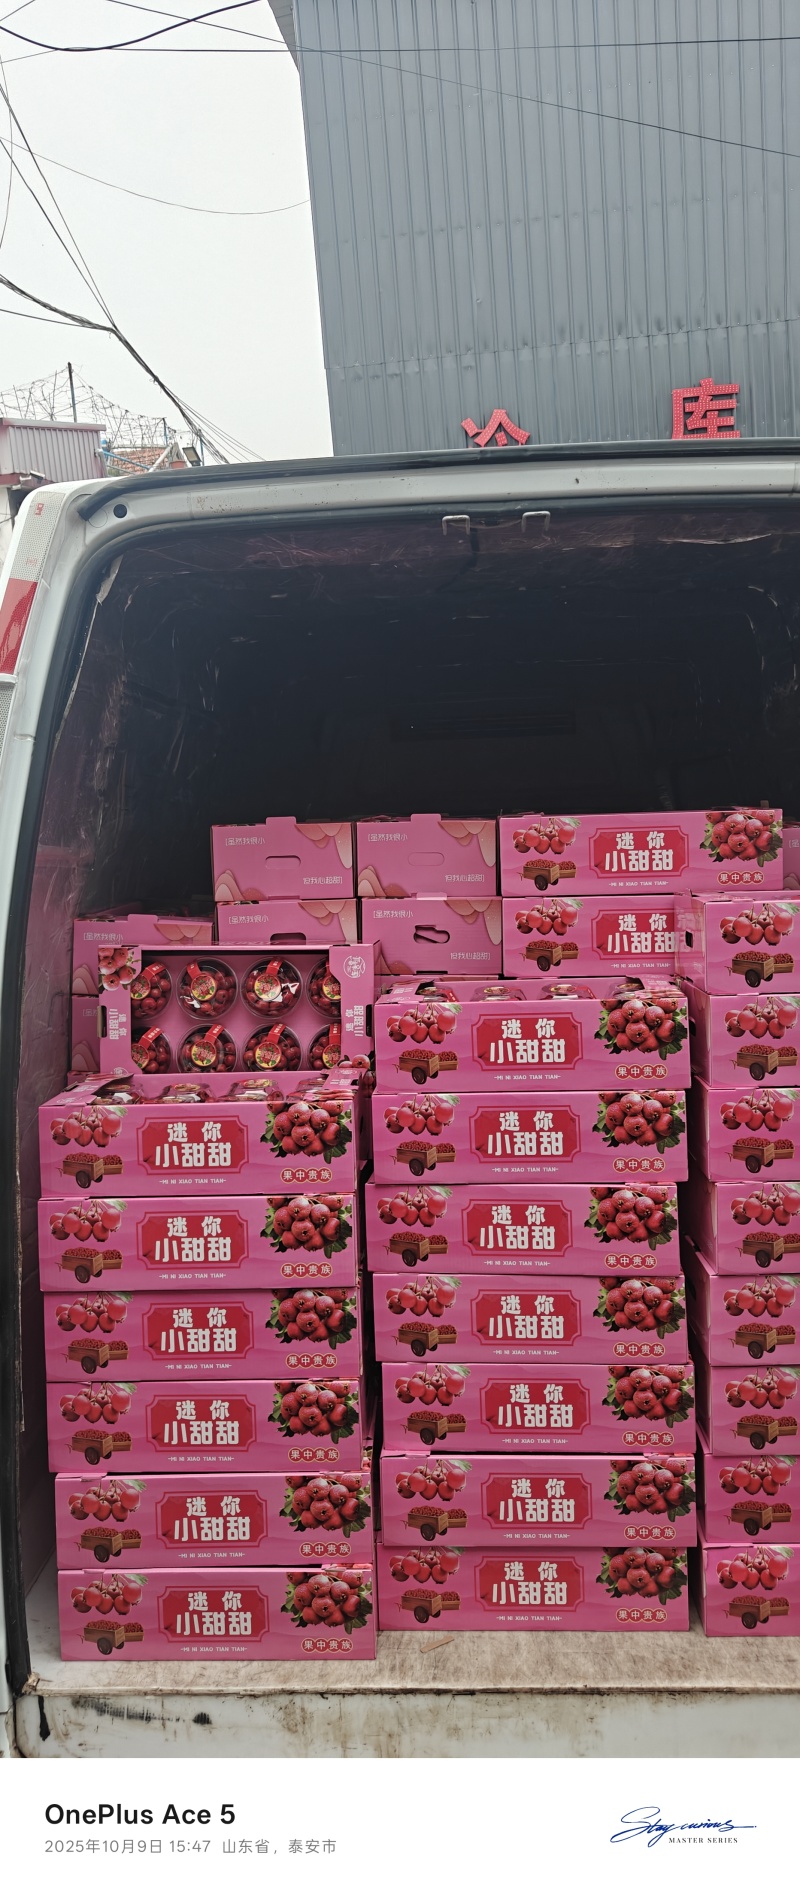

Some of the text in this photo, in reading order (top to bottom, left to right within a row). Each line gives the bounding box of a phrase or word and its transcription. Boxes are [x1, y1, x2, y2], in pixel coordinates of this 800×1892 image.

[616, 831, 665, 850] 迷你
[604, 849, 674, 872] 小甜甜
[719, 873, 763, 882] 果中贵族
[618, 914, 667, 932] 迷你
[607, 932, 675, 954] 小甜甜
[502, 1018, 555, 1038] 迷你
[490, 1040, 565, 1063] 小甜甜
[618, 1066, 666, 1077] 果中贵族
[499, 1111, 553, 1131] 迷你
[168, 1122, 221, 1142] 迷你
[488, 1132, 563, 1155] 小甜甜
[156, 1143, 231, 1167] 小甜甜
[616, 1159, 664, 1169] 果中贵族
[283, 1170, 331, 1180] 果中贵族
[492, 1205, 545, 1225] 迷你
[167, 1216, 221, 1236] 迷你
[480, 1226, 555, 1249] 小甜甜
[155, 1237, 231, 1262] 小甜甜
[283, 1265, 331, 1275] 果中贵族
[607, 1255, 655, 1266] 果中贵族
[501, 1295, 554, 1314] 迷你
[173, 1308, 226, 1327] 迷你
[489, 1316, 564, 1338] 小甜甜
[161, 1328, 236, 1352] 小甜甜
[616, 1344, 664, 1354] 果中贵族
[289, 1355, 336, 1366] 果中贵族
[510, 1384, 563, 1403] 迷你
[176, 1400, 229, 1420] 迷你
[498, 1405, 573, 1427] 小甜甜
[164, 1421, 239, 1444] 小甜甜
[625, 1432, 673, 1443] 果中贵族
[291, 1449, 338, 1459] 果中贵族
[512, 1479, 565, 1498] 迷你
[186, 1496, 240, 1516] 迷你
[500, 1499, 575, 1522] 小甜甜
[175, 1517, 250, 1541] 小甜甜
[627, 1527, 674, 1537] 果中贵族
[302, 1543, 350, 1554] 果中贵族
[504, 1562, 557, 1581] 迷你
[188, 1591, 241, 1611] 迷你
[493, 1582, 567, 1604] 小甜甜
[177, 1612, 251, 1635] 小甜甜
[619, 1610, 666, 1620] 果中贵族
[304, 1639, 352, 1649] 果中贵族
